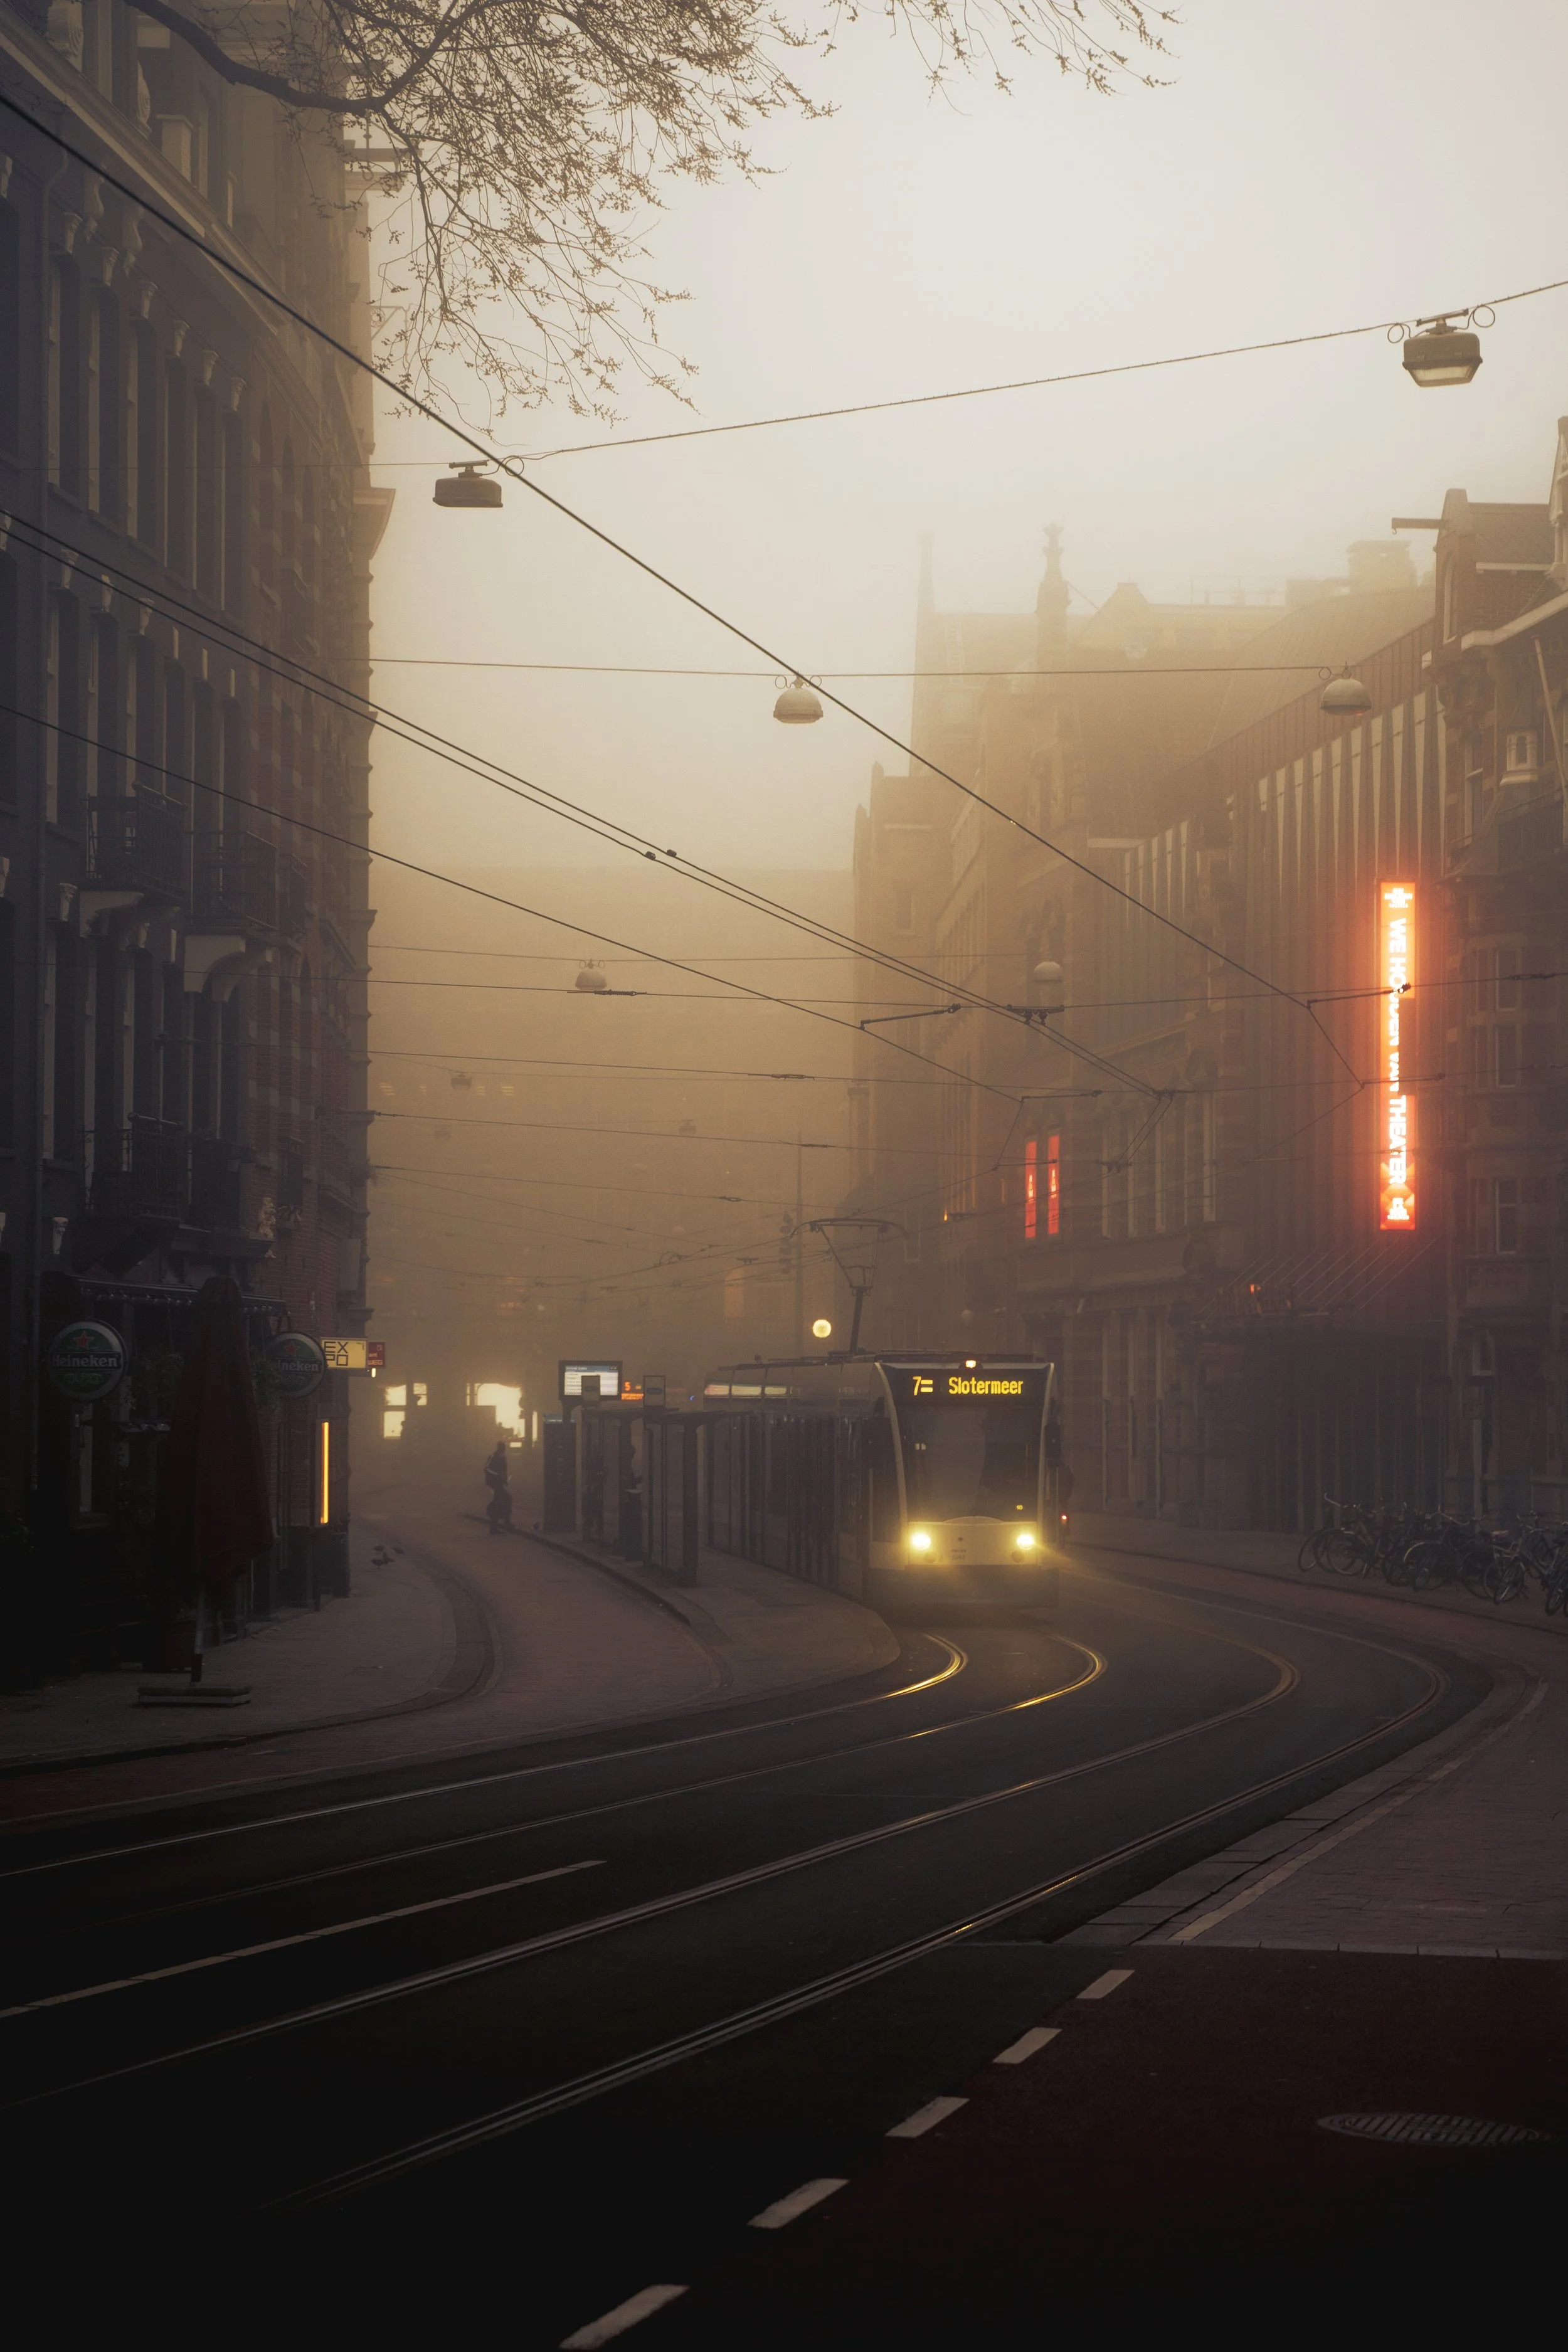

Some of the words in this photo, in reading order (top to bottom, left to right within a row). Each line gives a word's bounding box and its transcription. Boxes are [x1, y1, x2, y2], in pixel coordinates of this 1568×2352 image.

[1389, 917, 1407, 953] WE
[1389, 1094, 1407, 1185] THEATER
[51, 1353, 118, 1367] Heineken
[948, 1377, 1024, 1394] Slotermeer
